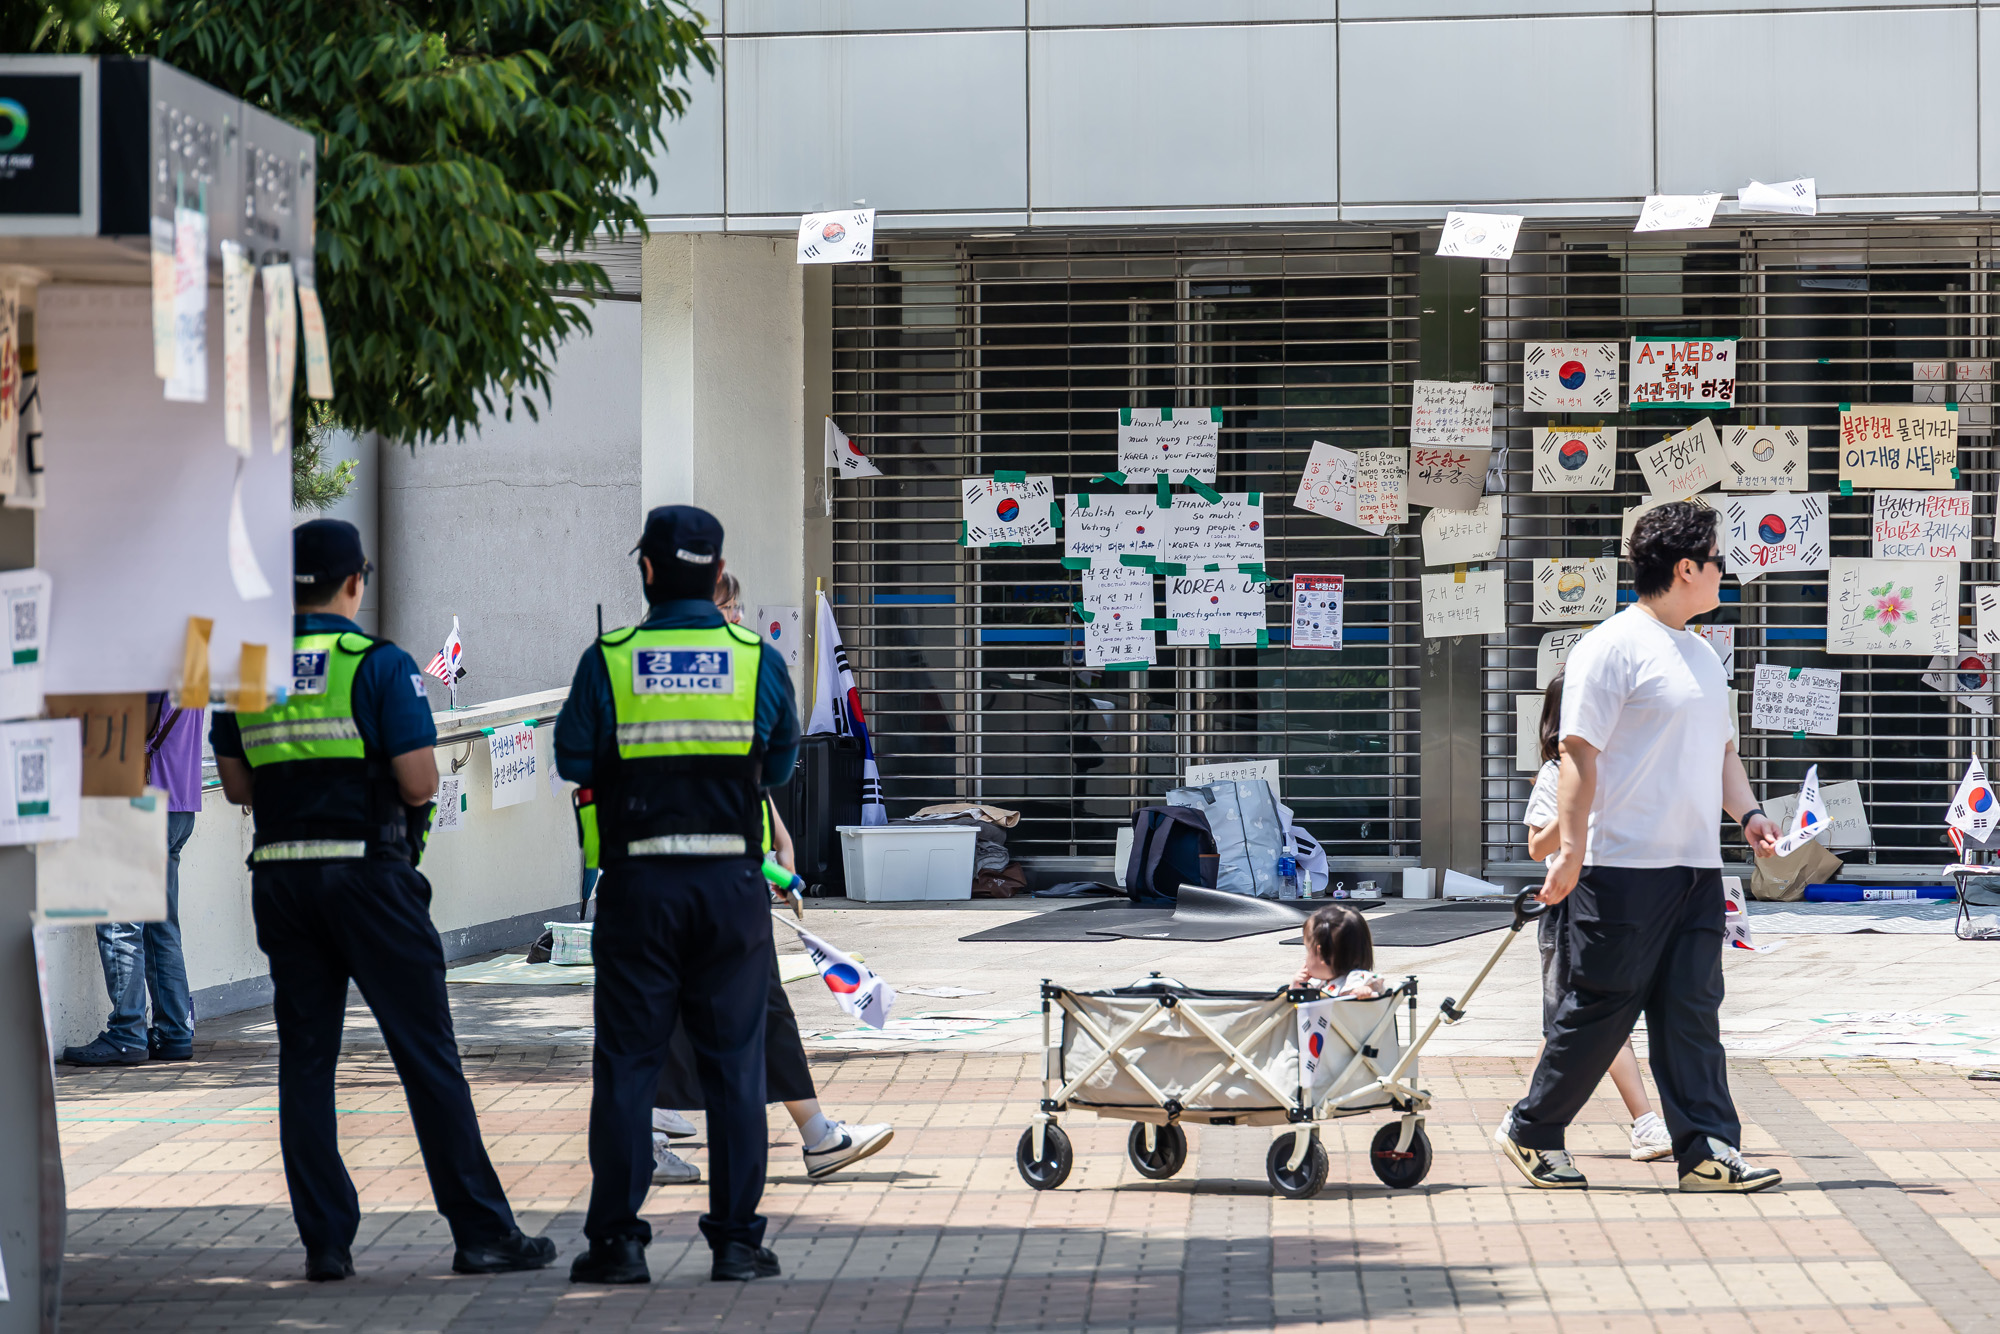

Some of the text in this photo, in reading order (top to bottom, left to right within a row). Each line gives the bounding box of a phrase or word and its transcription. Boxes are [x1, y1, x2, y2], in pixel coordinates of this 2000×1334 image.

[1634, 378, 1735, 402] 선관위가 하청
[1897, 418, 1956, 442] 물러가라
[1156, 436, 1180, 445] young
[1650, 432, 1706, 477] 부정선거
[1846, 446, 1956, 475] 이재명 사퇴하라
[1172, 467, 1201, 475] country
[1419, 466, 1462, 484] 대동강
[1668, 464, 1708, 493] 재선거
[1358, 481, 1399, 492] 내란은 민주당
[1736, 476, 1767, 486] 부정선거
[1359, 494, 1376, 503] 선관위
[1125, 504, 1153, 519] early
[1360, 500, 1398, 514] 이재명 탄핵
[1877, 494, 1926, 519] 부정선거
[1378, 515, 1401, 524] 받아라
[1174, 525, 1200, 535] young
[1439, 521, 1488, 541] 보장하라
[1875, 520, 1971, 542] 한미공조 국제수사
[1750, 544, 1796, 566] 90일간의
[1883, 543, 1956, 558] KOREA USA
[1172, 578, 1225, 594] KOREA
[1172, 608, 1231, 620] investigation
[1427, 606, 1480, 625] 자유 대한민국
[646, 652, 722, 674] 경찰
[645, 677, 722, 689] POLICE
[1757, 714, 1821, 727] STOP THE STEAL!
[491, 730, 533, 758] 부정선거 재선거
[1195, 772, 1215, 784] 자유
